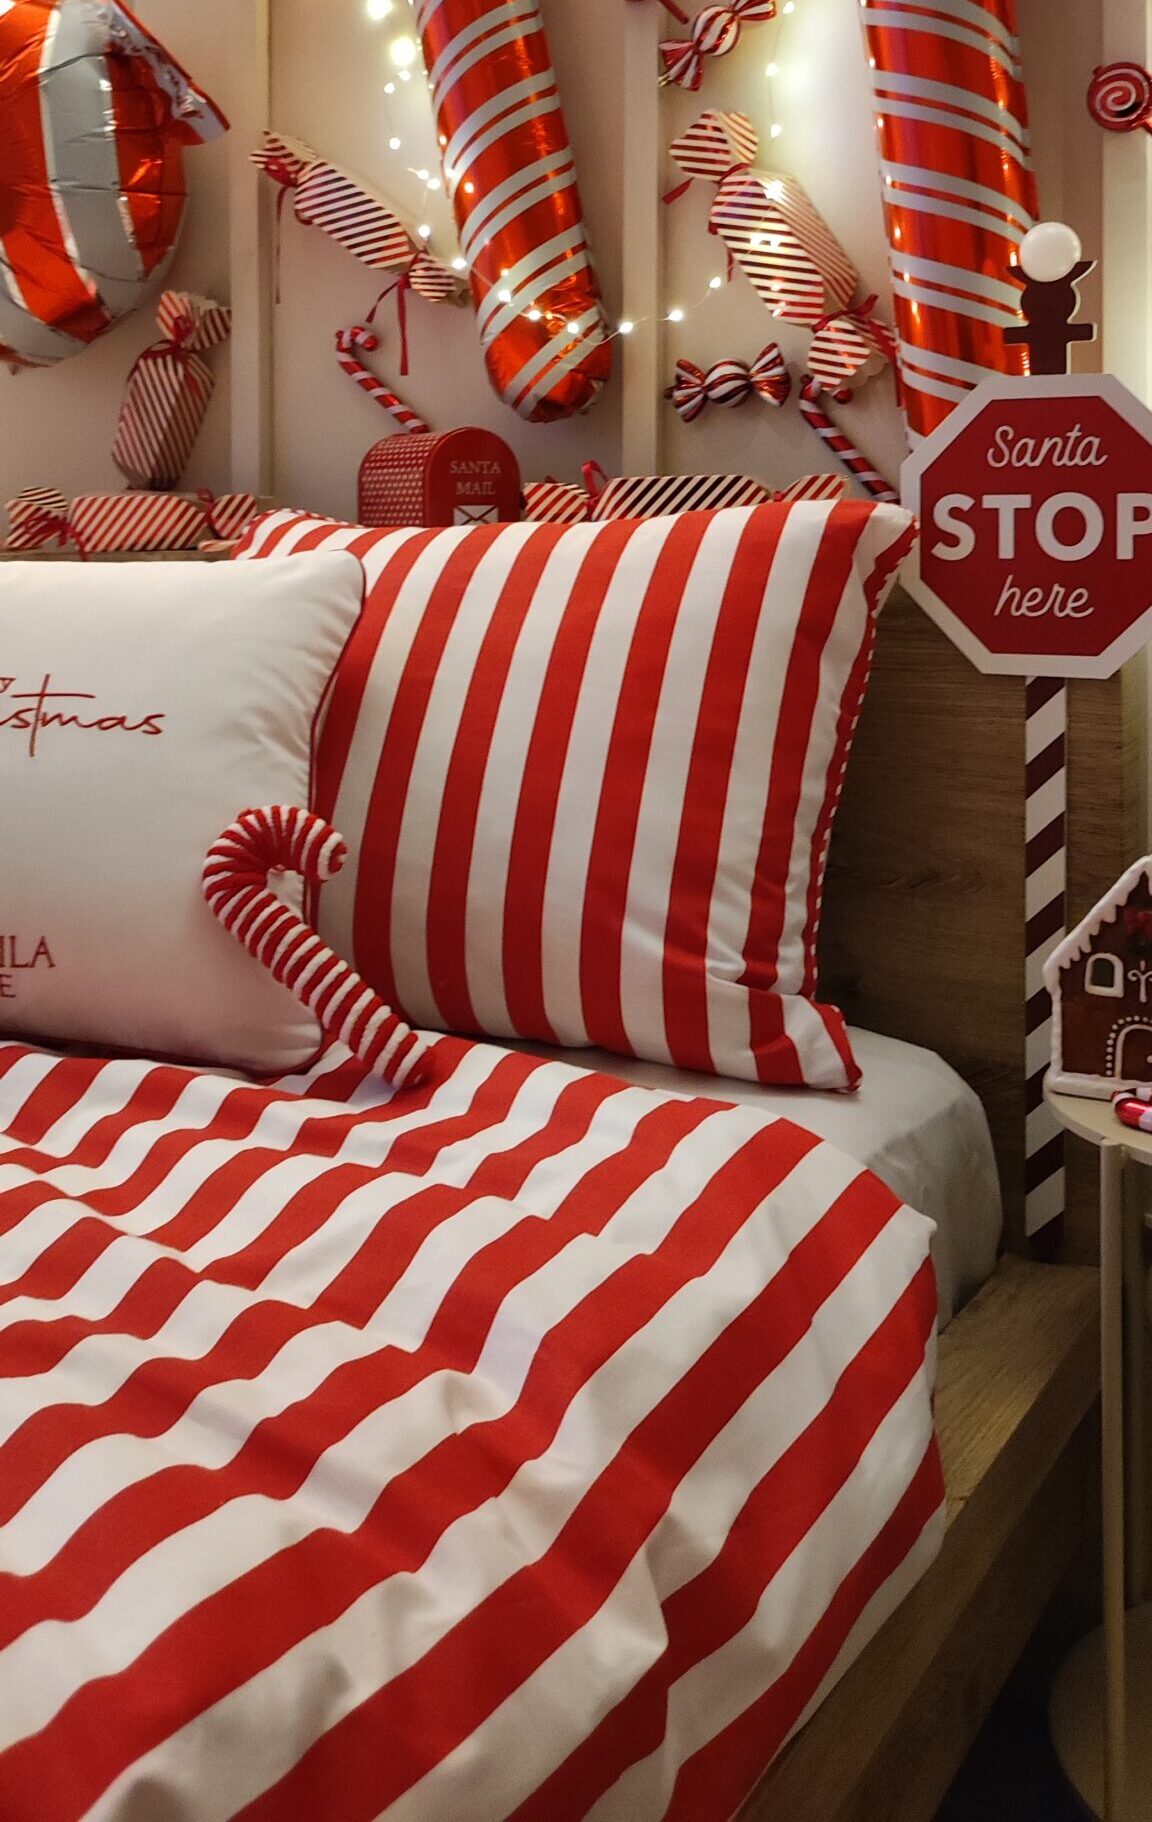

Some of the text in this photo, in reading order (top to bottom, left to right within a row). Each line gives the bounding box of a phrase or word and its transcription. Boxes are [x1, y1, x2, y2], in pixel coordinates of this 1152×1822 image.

[450, 461, 501, 474] SANTA
[986, 424, 1108, 468] Santa
[456, 482, 496, 495] MAIL
[931, 492, 1152, 562] STOP
[994, 575, 1095, 618] here
